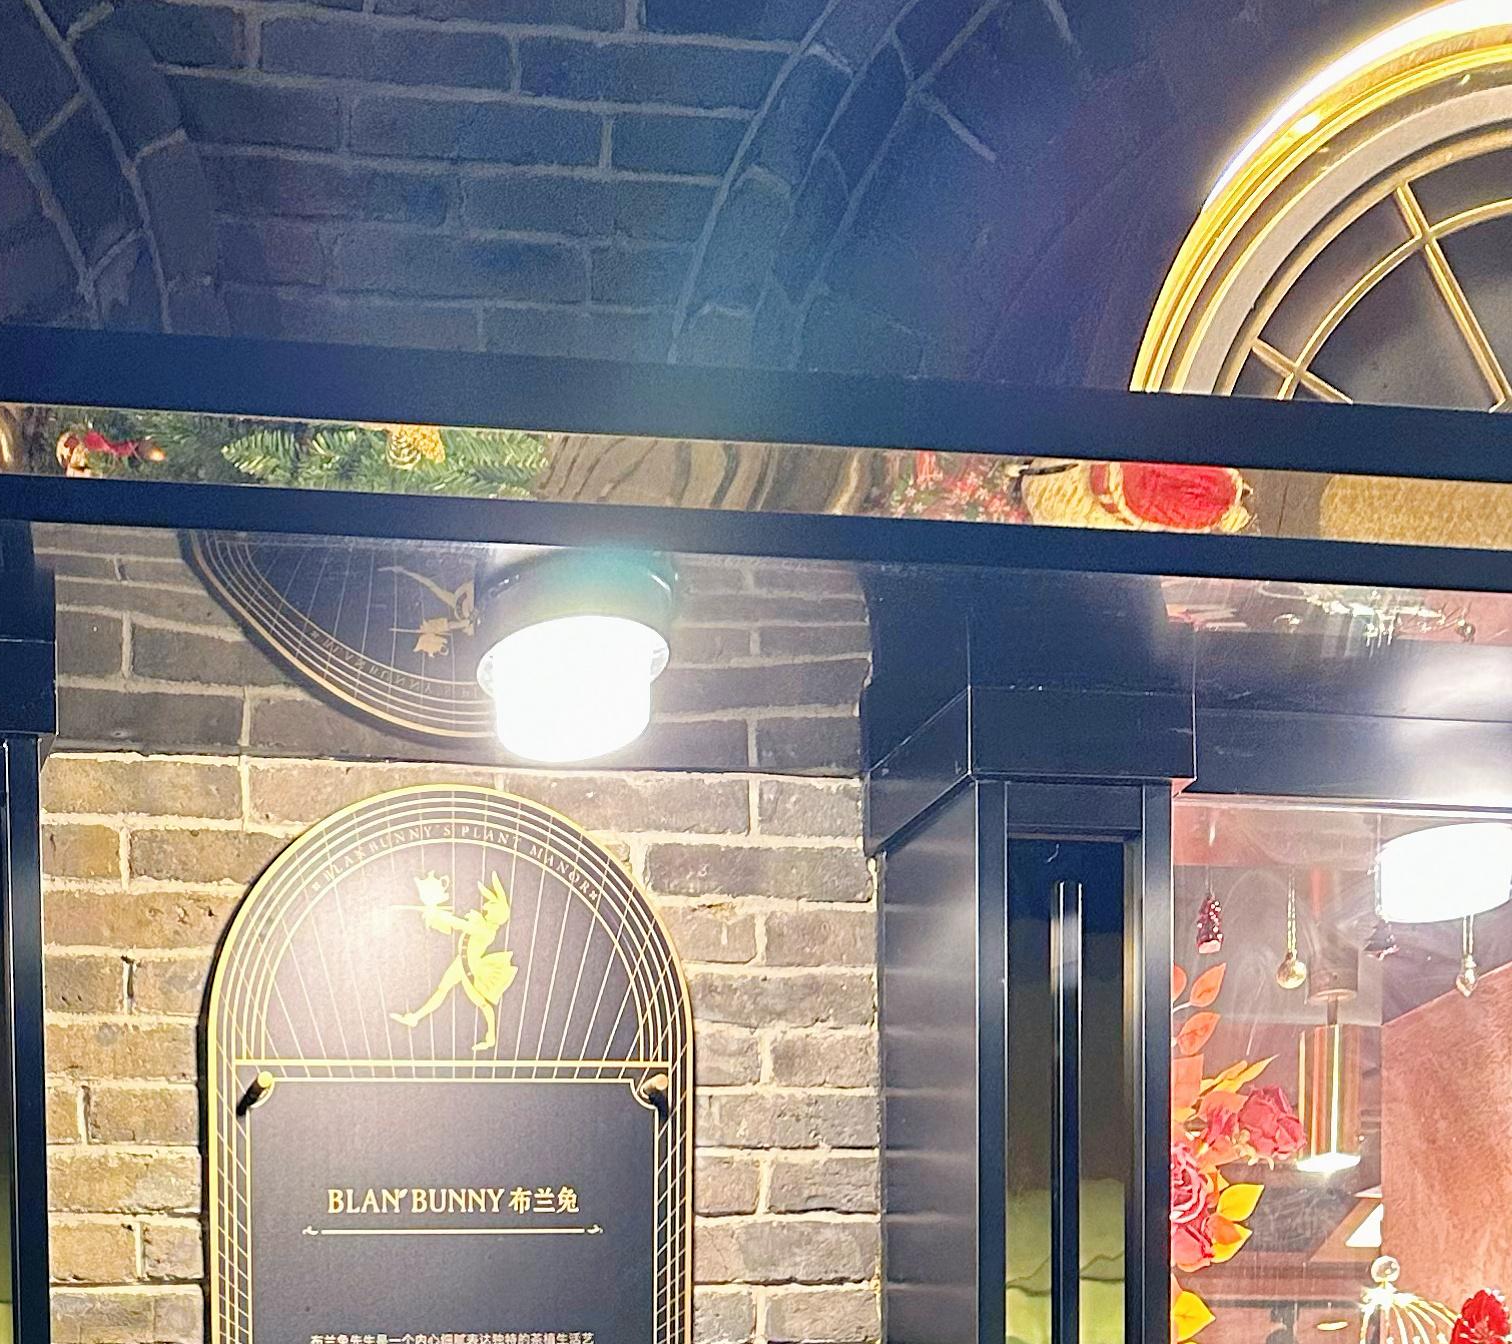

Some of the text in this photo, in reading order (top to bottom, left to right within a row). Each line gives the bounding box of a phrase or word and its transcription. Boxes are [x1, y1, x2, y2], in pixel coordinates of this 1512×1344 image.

[461, 826, 522, 851] PLANT
[529, 845, 591, 894] MANOR
[411, 1188, 504, 1213] BUNNY
[508, 1186, 579, 1214] 布兰兔
